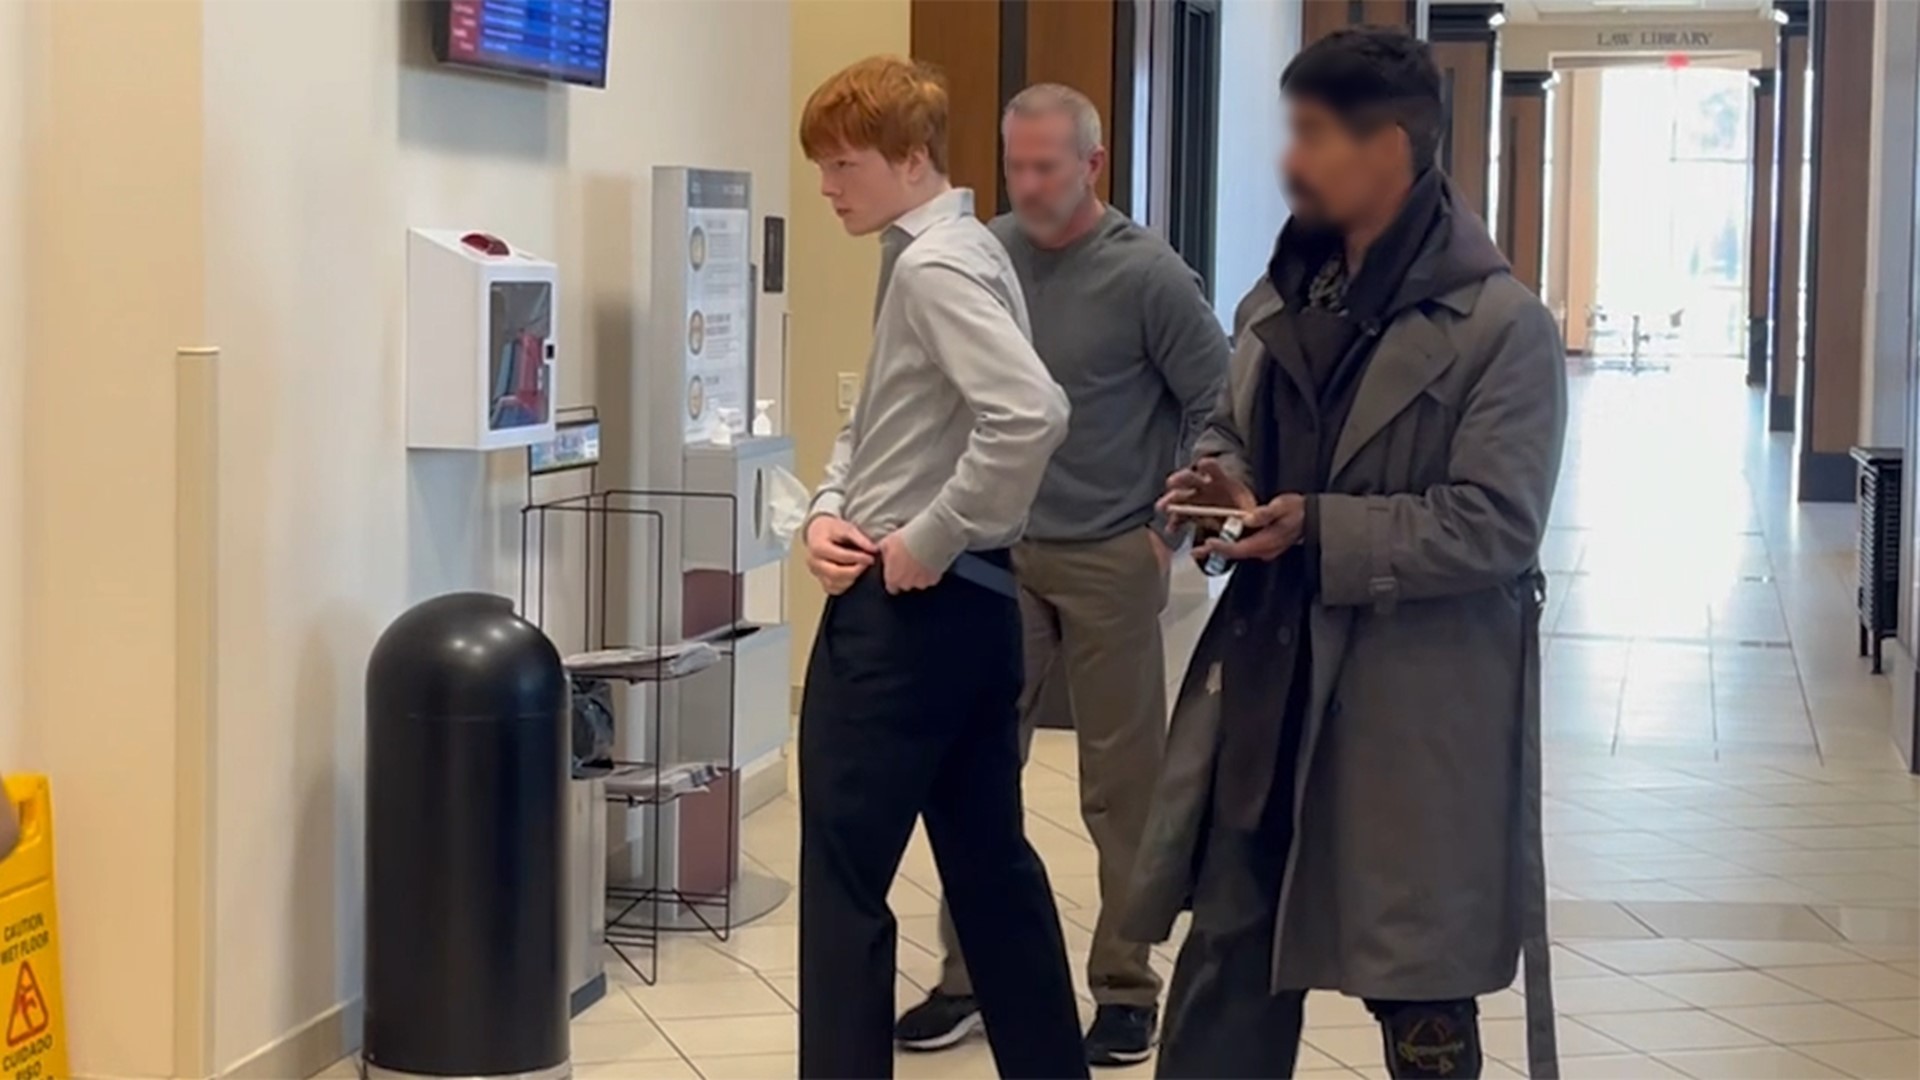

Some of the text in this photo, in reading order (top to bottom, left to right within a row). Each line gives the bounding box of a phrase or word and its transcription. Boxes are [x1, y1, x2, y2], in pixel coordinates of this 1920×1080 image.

[1597, 31, 1713, 46] LAW LIBRARY
[4, 912, 44, 942] CAUTION
[0, 930, 49, 965] WET FLOOR
[3, 1033, 53, 1073] CUIDADO
